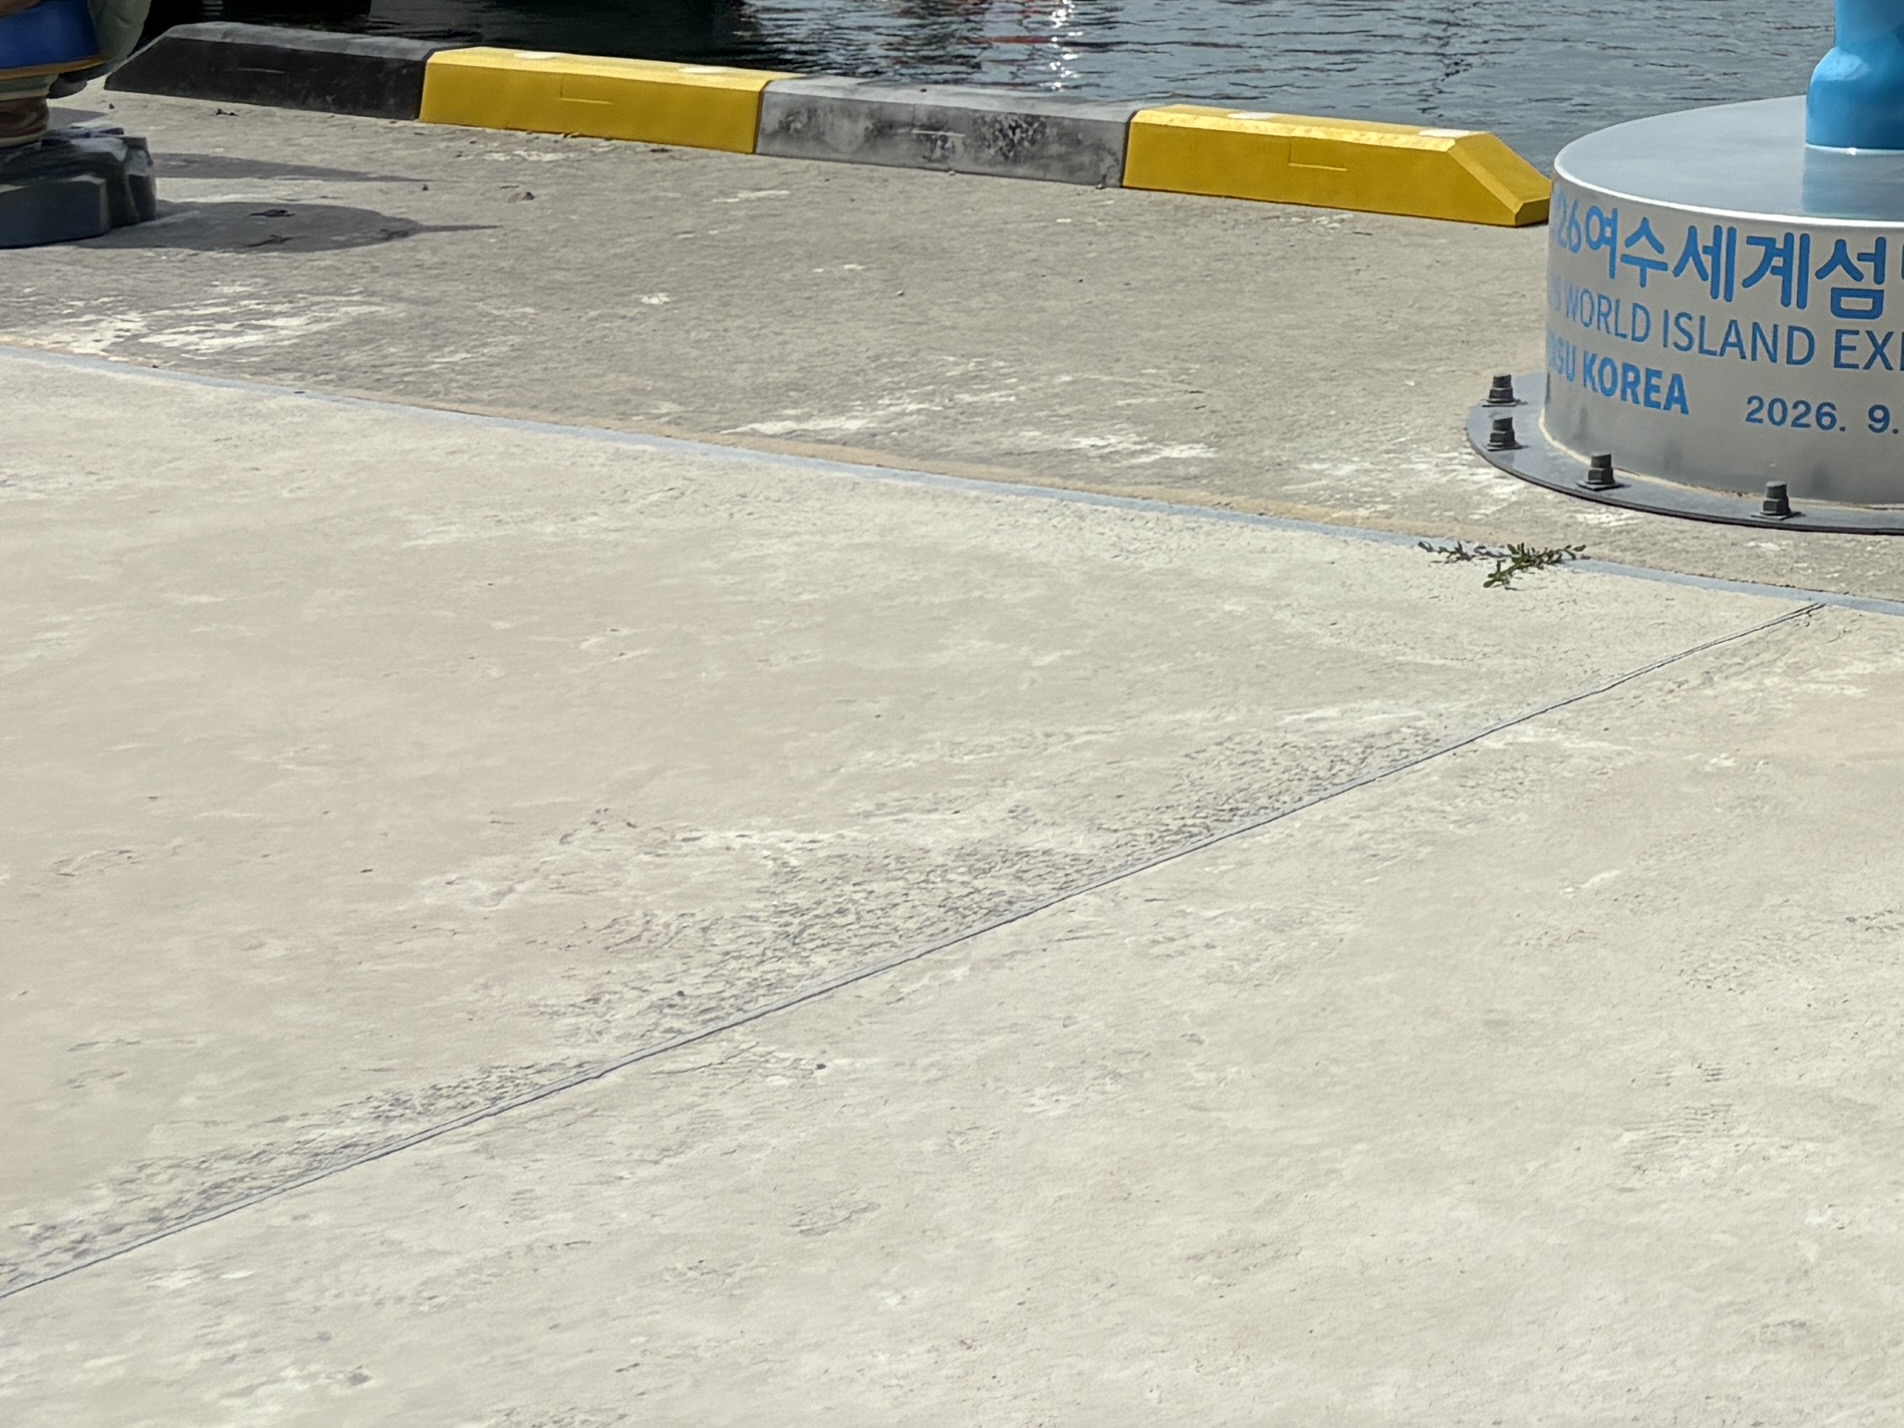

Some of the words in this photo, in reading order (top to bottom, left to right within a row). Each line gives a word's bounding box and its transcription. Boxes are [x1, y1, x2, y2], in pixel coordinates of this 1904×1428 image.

[1565, 282, 1651, 343] WORLD
[1663, 309, 1816, 366] ISLAND
[1583, 350, 1690, 416] KOREA
[1745, 395, 1846, 432] 2026.
[1868, 404, 1900, 435] 9.
